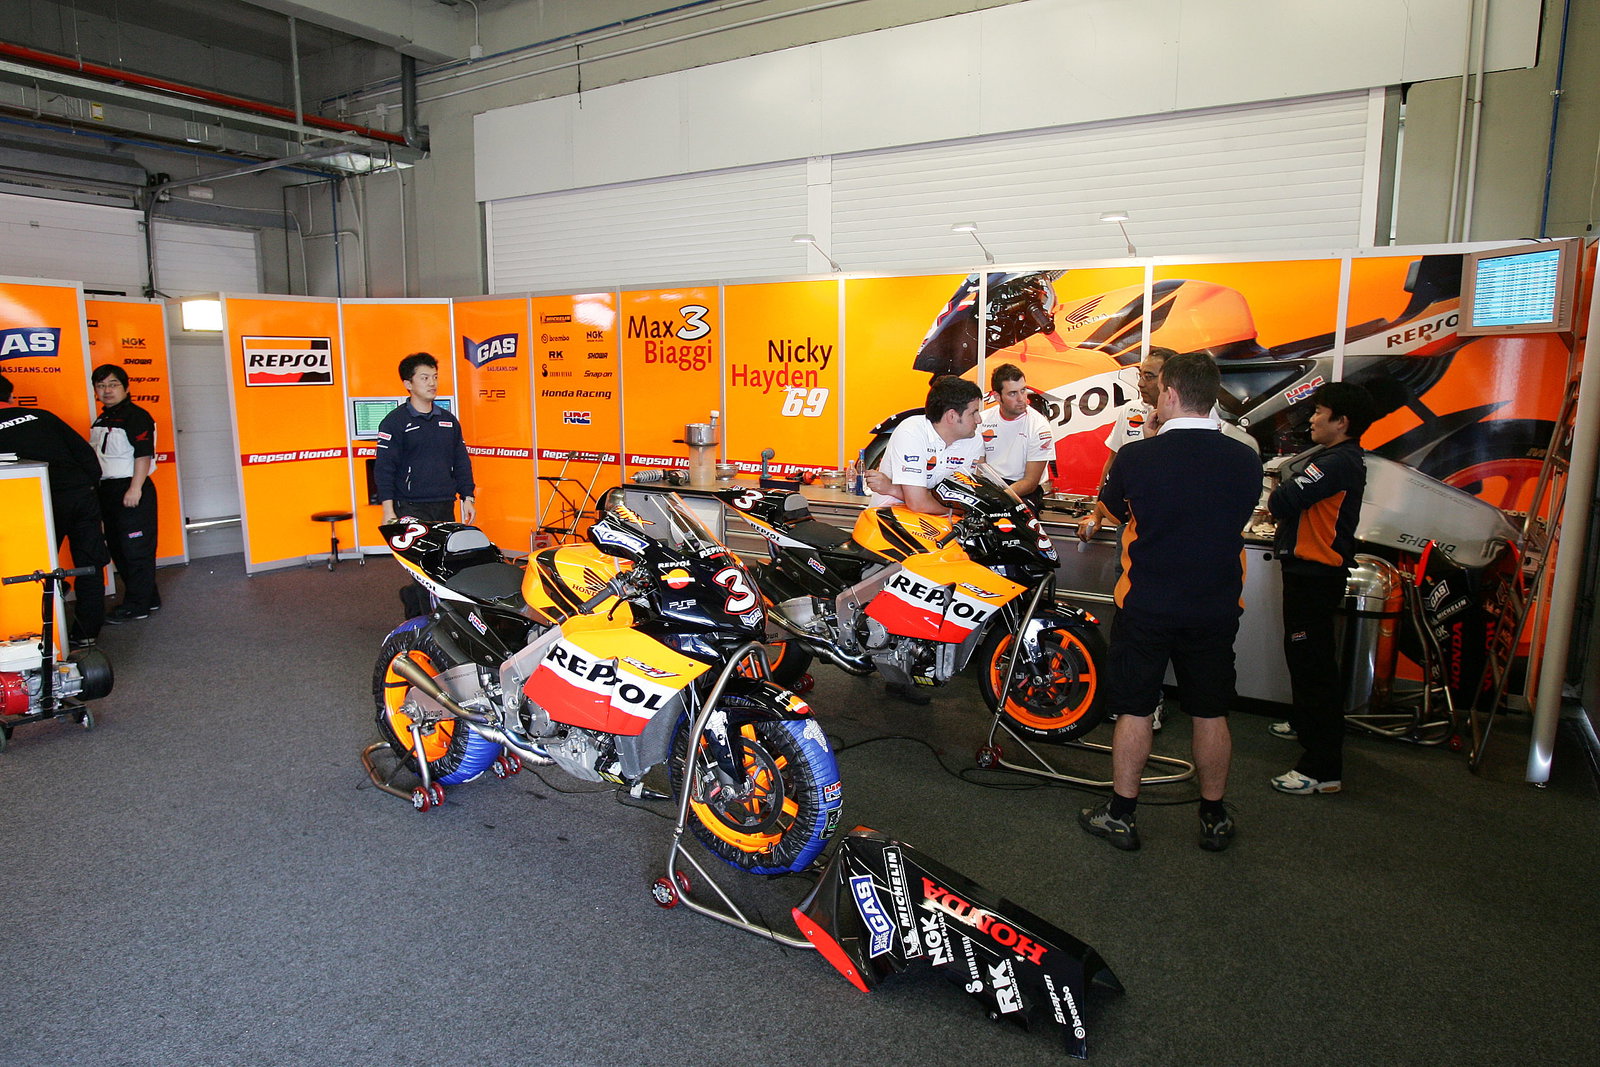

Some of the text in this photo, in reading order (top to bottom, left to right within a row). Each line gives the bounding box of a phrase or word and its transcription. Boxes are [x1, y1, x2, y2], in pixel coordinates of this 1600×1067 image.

[586, 331, 603, 339] NGK
[628, 304, 711, 341] Max 3
[1387, 313, 1459, 348] REPSO
[0, 333, 55, 356] AS
[122, 338, 146, 346] NGK
[477, 338, 515, 363] GAS
[549, 351, 563, 359] RK
[644, 340, 712, 371] Biaggi
[768, 337, 833, 370] Nicky
[1, 366, 61, 374] ASJEANS.COM
[249, 354, 328, 368] REPSOL
[731, 362, 818, 394] Hayden
[1284, 376, 1325, 405] HRC
[130, 394, 160, 403] cing
[541, 389, 612, 400] Honda Racing
[781, 387, 829, 417] 69
[563, 411, 591, 425] HRC
[249, 449, 342, 464] Repsol Honda
[466, 446, 529, 457] Repsol Honda
[542, 450, 578, 460] Repsl
[631, 455, 672, 466] Repsol
[732, 489, 766, 511] 3
[390, 523, 429, 551] 3
[658, 560, 691, 569] REPSOL
[712, 566, 760, 616] 3
[891, 574, 989, 625] REPSOL
[468, 611, 488, 636] HRC
[1435, 624, 1449, 638] GK
[546, 643, 665, 711] REPSOL
[887, 852, 911, 928] MICHELIN
[856, 881, 890, 933] GAS
[921, 876, 1049, 966] HONDA
[920, 913, 948, 967] NGK
[937, 911, 955, 962] SPARK PLUGS
[988, 959, 1019, 1014] RK
[1043, 974, 1067, 1025] Snap-on
[1062, 985, 1083, 1028] brembo
